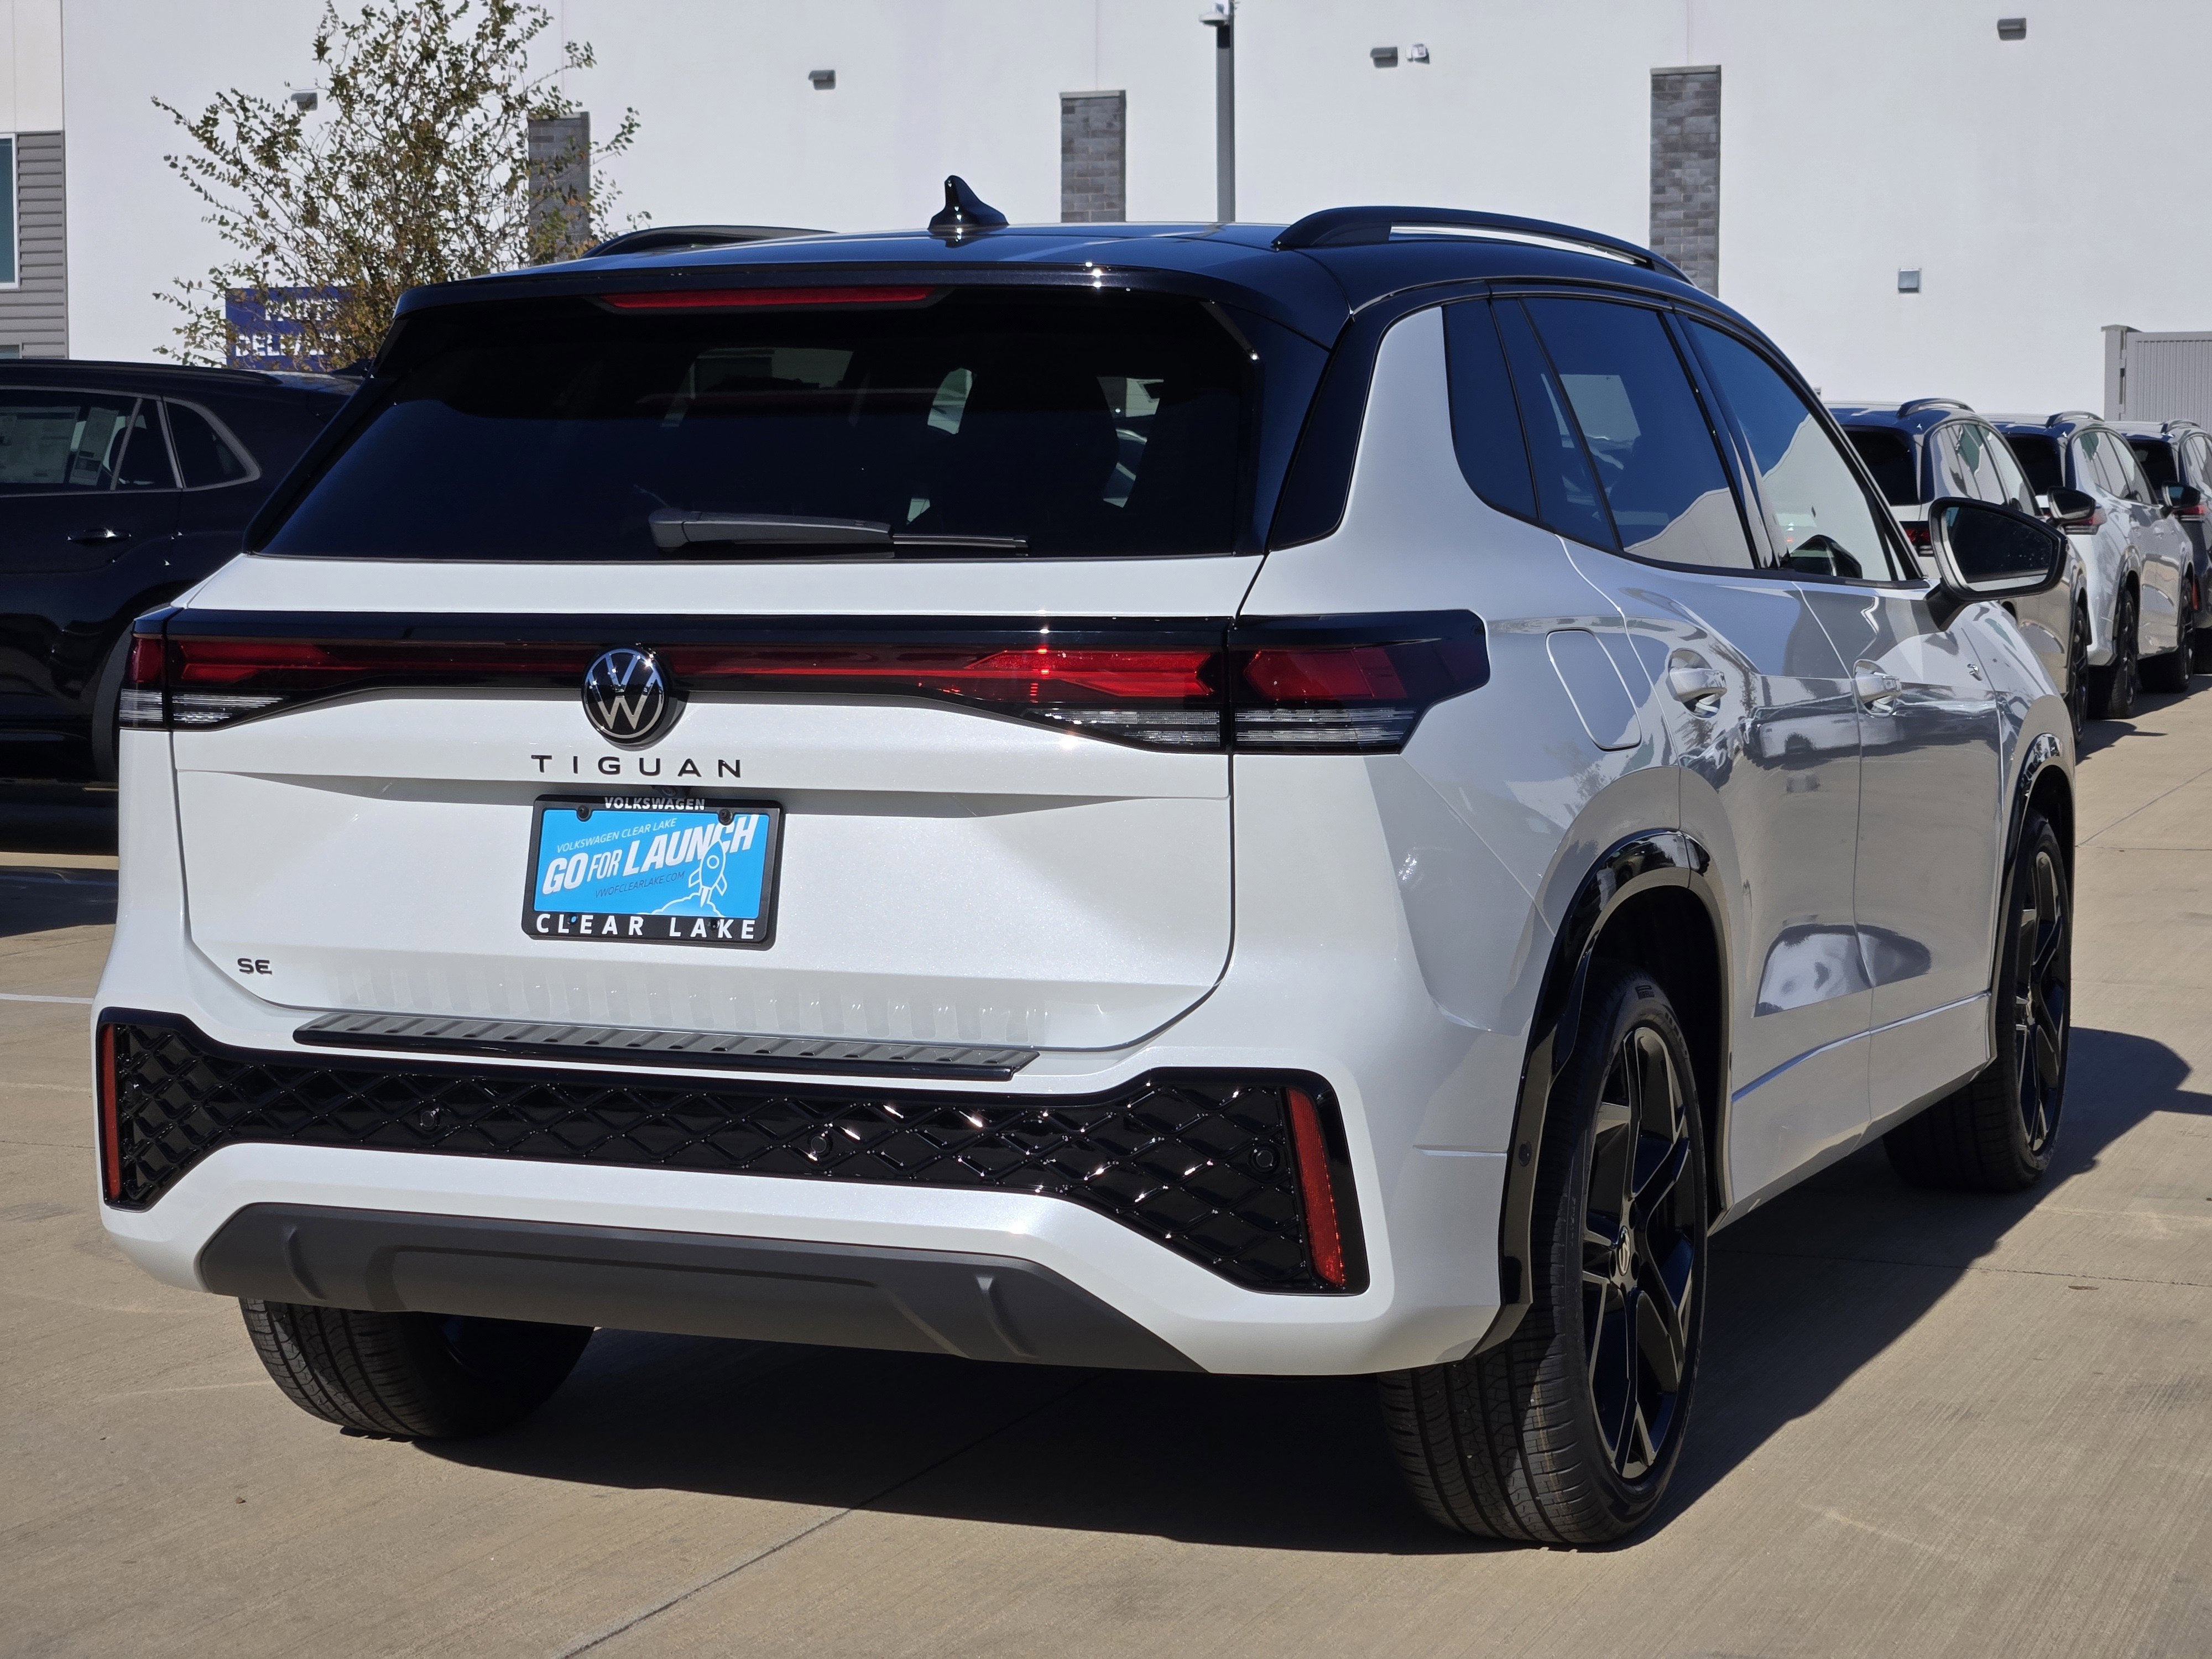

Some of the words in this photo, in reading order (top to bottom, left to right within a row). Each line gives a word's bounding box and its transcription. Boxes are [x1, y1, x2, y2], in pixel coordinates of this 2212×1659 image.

[531, 754, 742, 778] TIGUAN
[604, 797, 705, 811] VOLKSWAGEN
[556, 831, 619, 853] VOLKSWAGEN
[621, 823, 651, 838] CLEAR
[652, 817, 678, 832] LAKE
[542, 852, 589, 895] GO
[586, 849, 623, 882] FOR
[622, 814, 760, 877] LAUNCH
[536, 913, 644, 936] CLEAR
[669, 918, 755, 940] LAKE
[237, 958, 273, 975] SE
